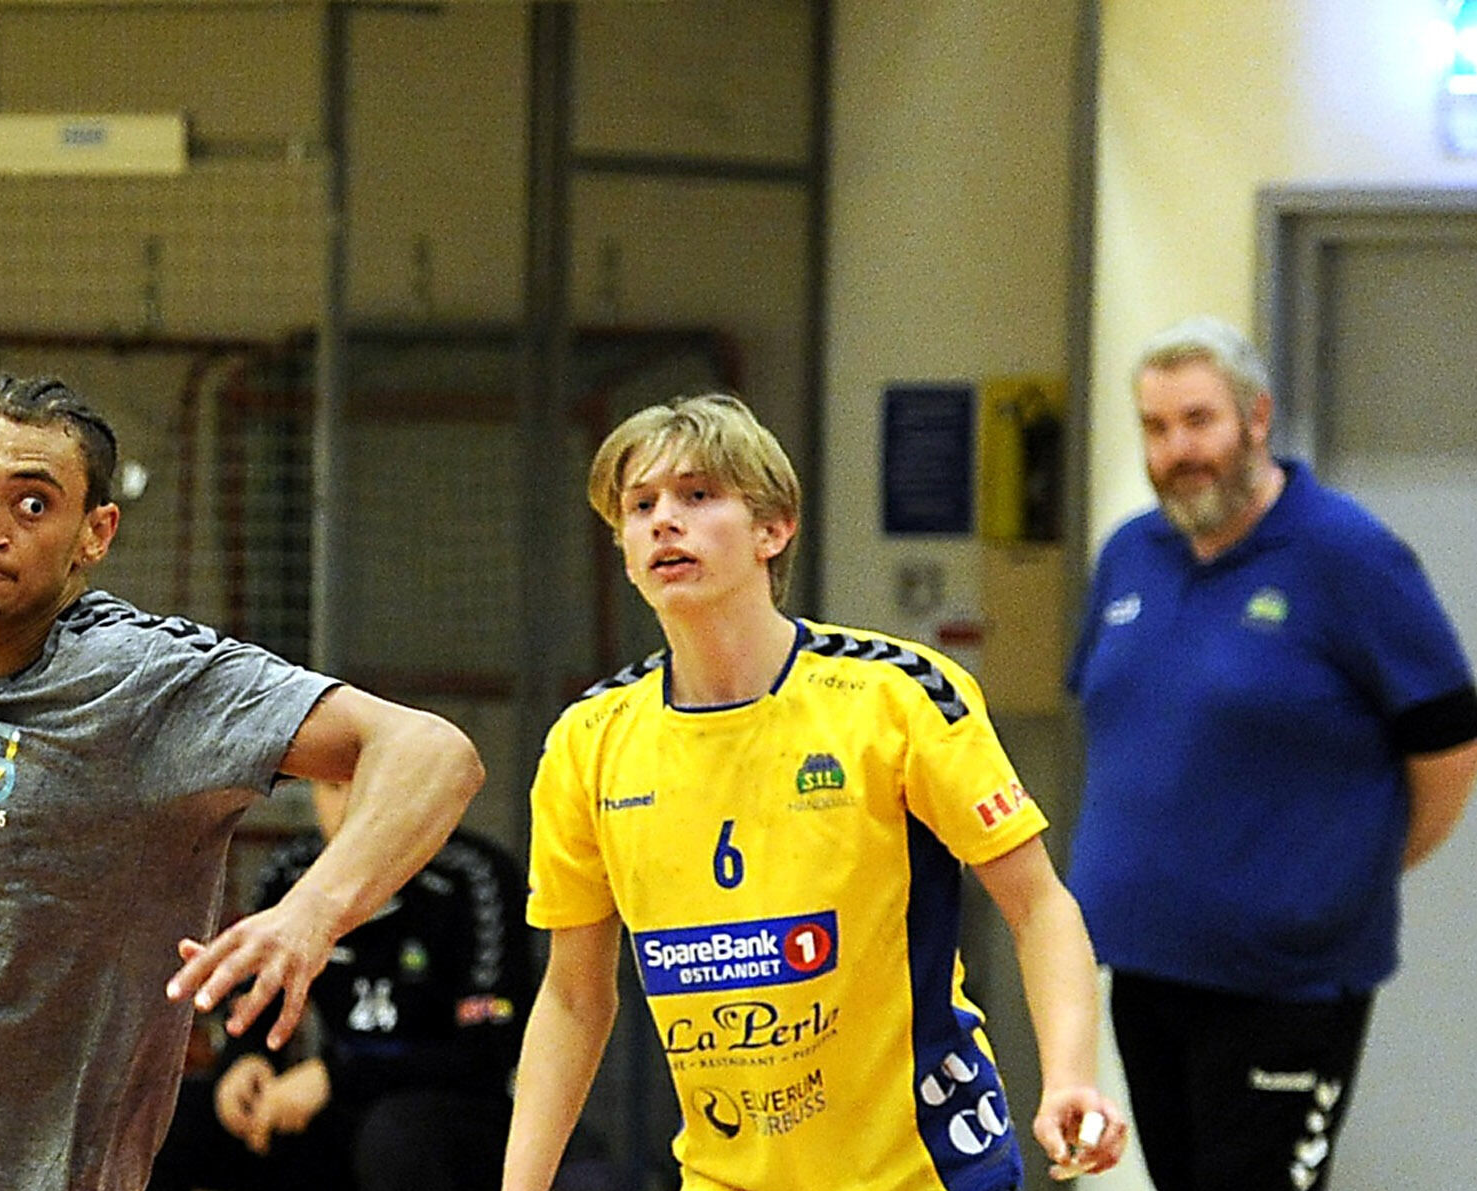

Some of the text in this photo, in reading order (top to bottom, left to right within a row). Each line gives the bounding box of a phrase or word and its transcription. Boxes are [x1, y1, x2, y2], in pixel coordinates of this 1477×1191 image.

[713, 819, 744, 889] 6
[644, 929, 816, 970] SpareBank 1
[666, 1018, 717, 1054] La
